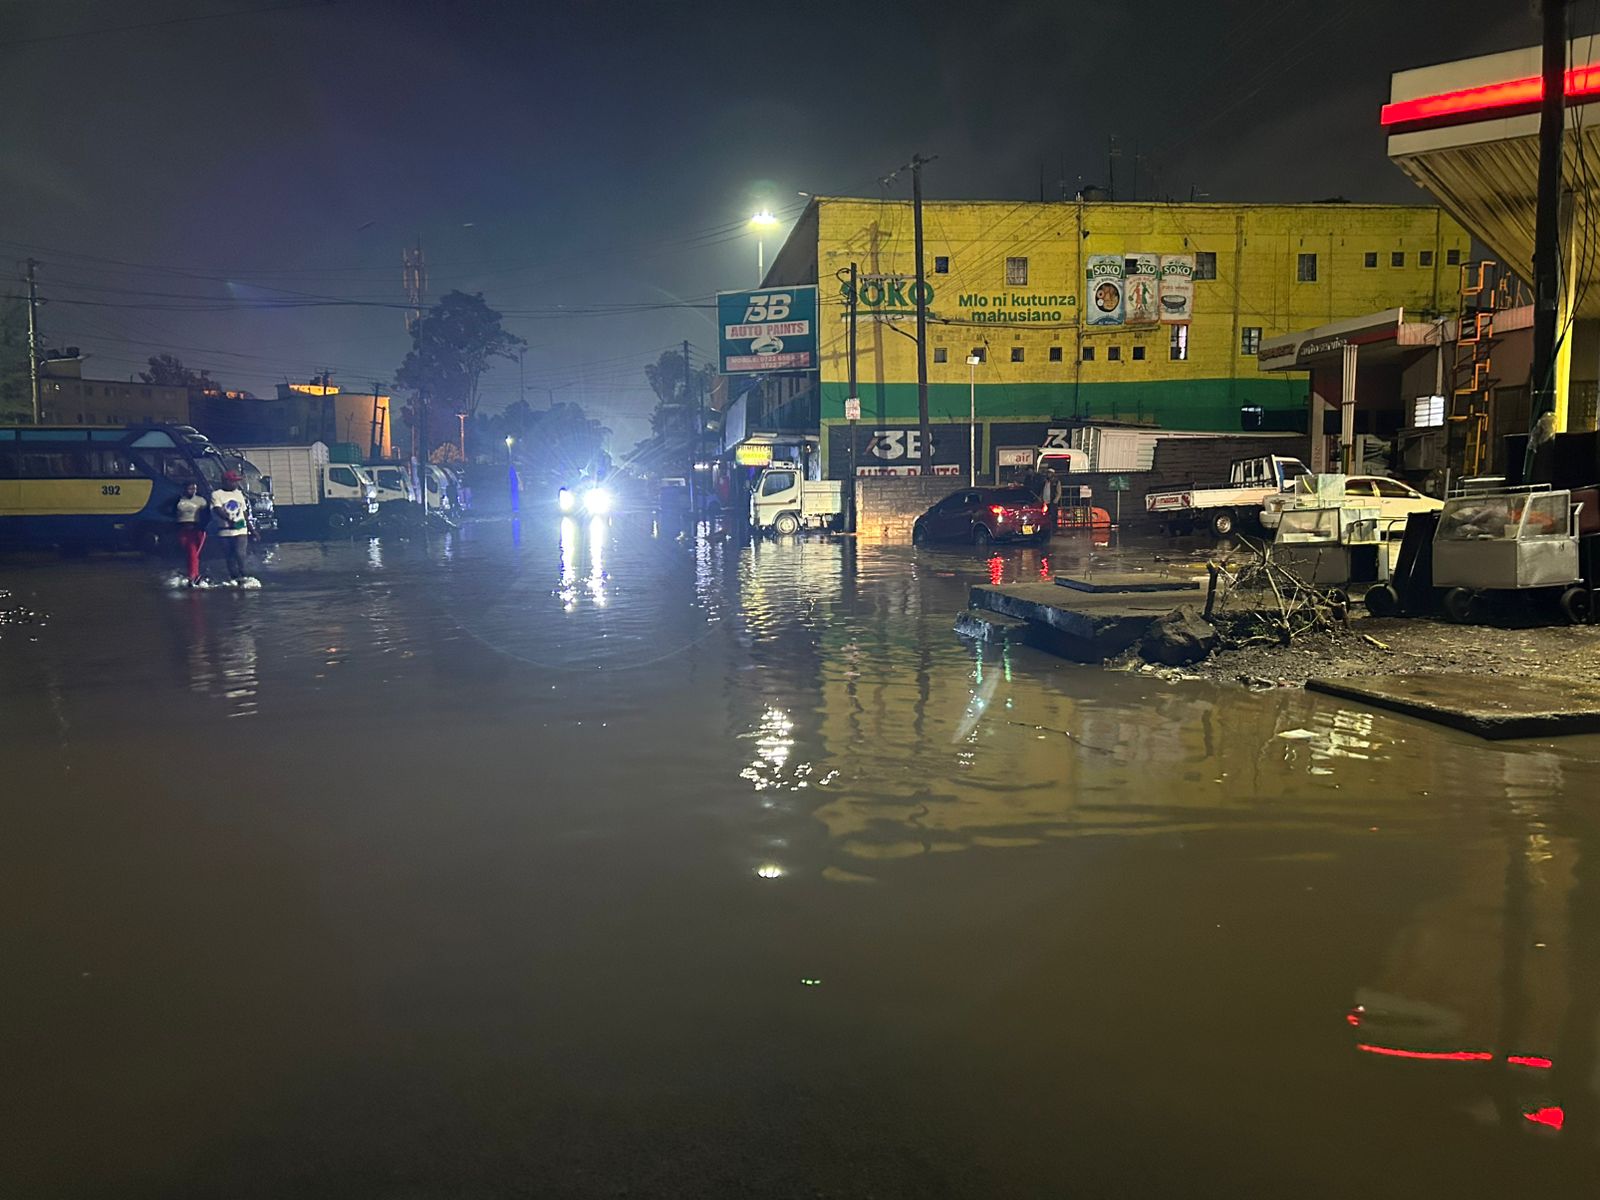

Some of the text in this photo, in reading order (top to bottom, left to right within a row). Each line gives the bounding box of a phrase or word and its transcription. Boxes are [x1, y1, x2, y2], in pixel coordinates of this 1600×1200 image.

[1093, 264, 1120, 275] SOKO
[1136, 264, 1156, 275] OKO
[1163, 265, 1190, 276] SOKO
[958, 292, 1076, 307] Mlo ni kutunza
[744, 294, 791, 322] 3B
[971, 308, 1062, 322] mahusiano
[730, 322, 804, 338] AUTO PAINTS
[864, 429, 936, 460] 3B
[1015, 451, 1031, 463] air
[101, 485, 121, 496] 392
